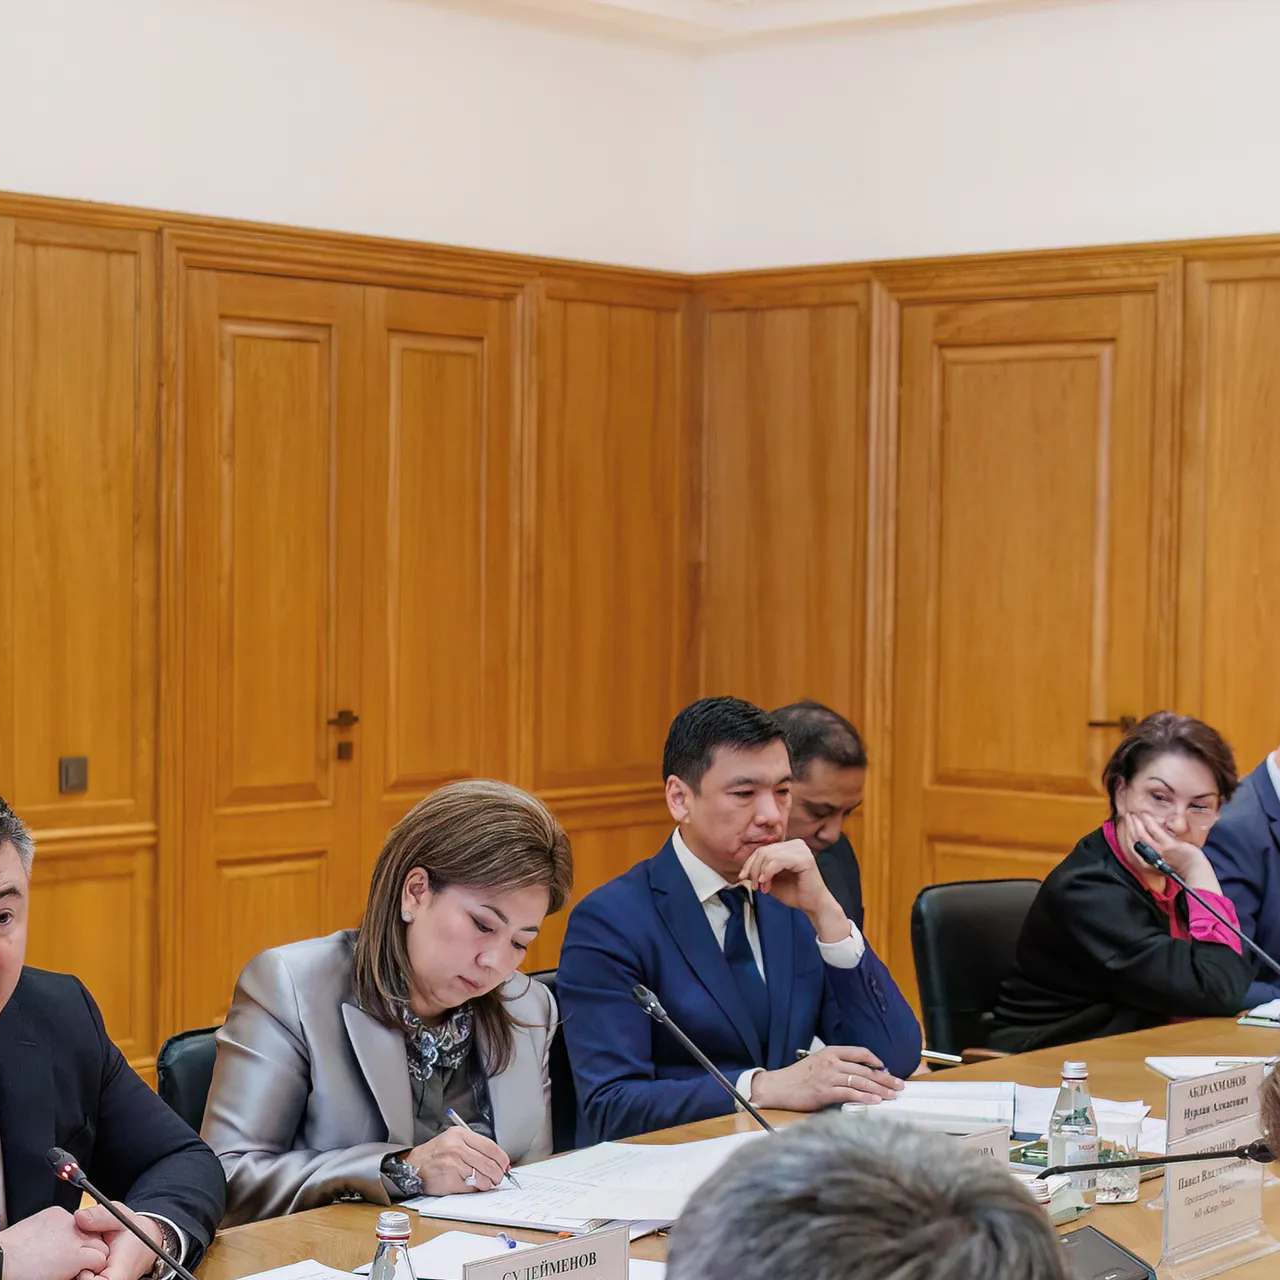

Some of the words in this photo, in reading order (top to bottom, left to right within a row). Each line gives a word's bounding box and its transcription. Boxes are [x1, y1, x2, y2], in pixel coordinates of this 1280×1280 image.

[1188, 1075, 1247, 1099] АБДРАХМАНОВ
[1183, 1106, 1211, 1121] Нурлан
[1177, 1175, 1201, 1191] Павел
